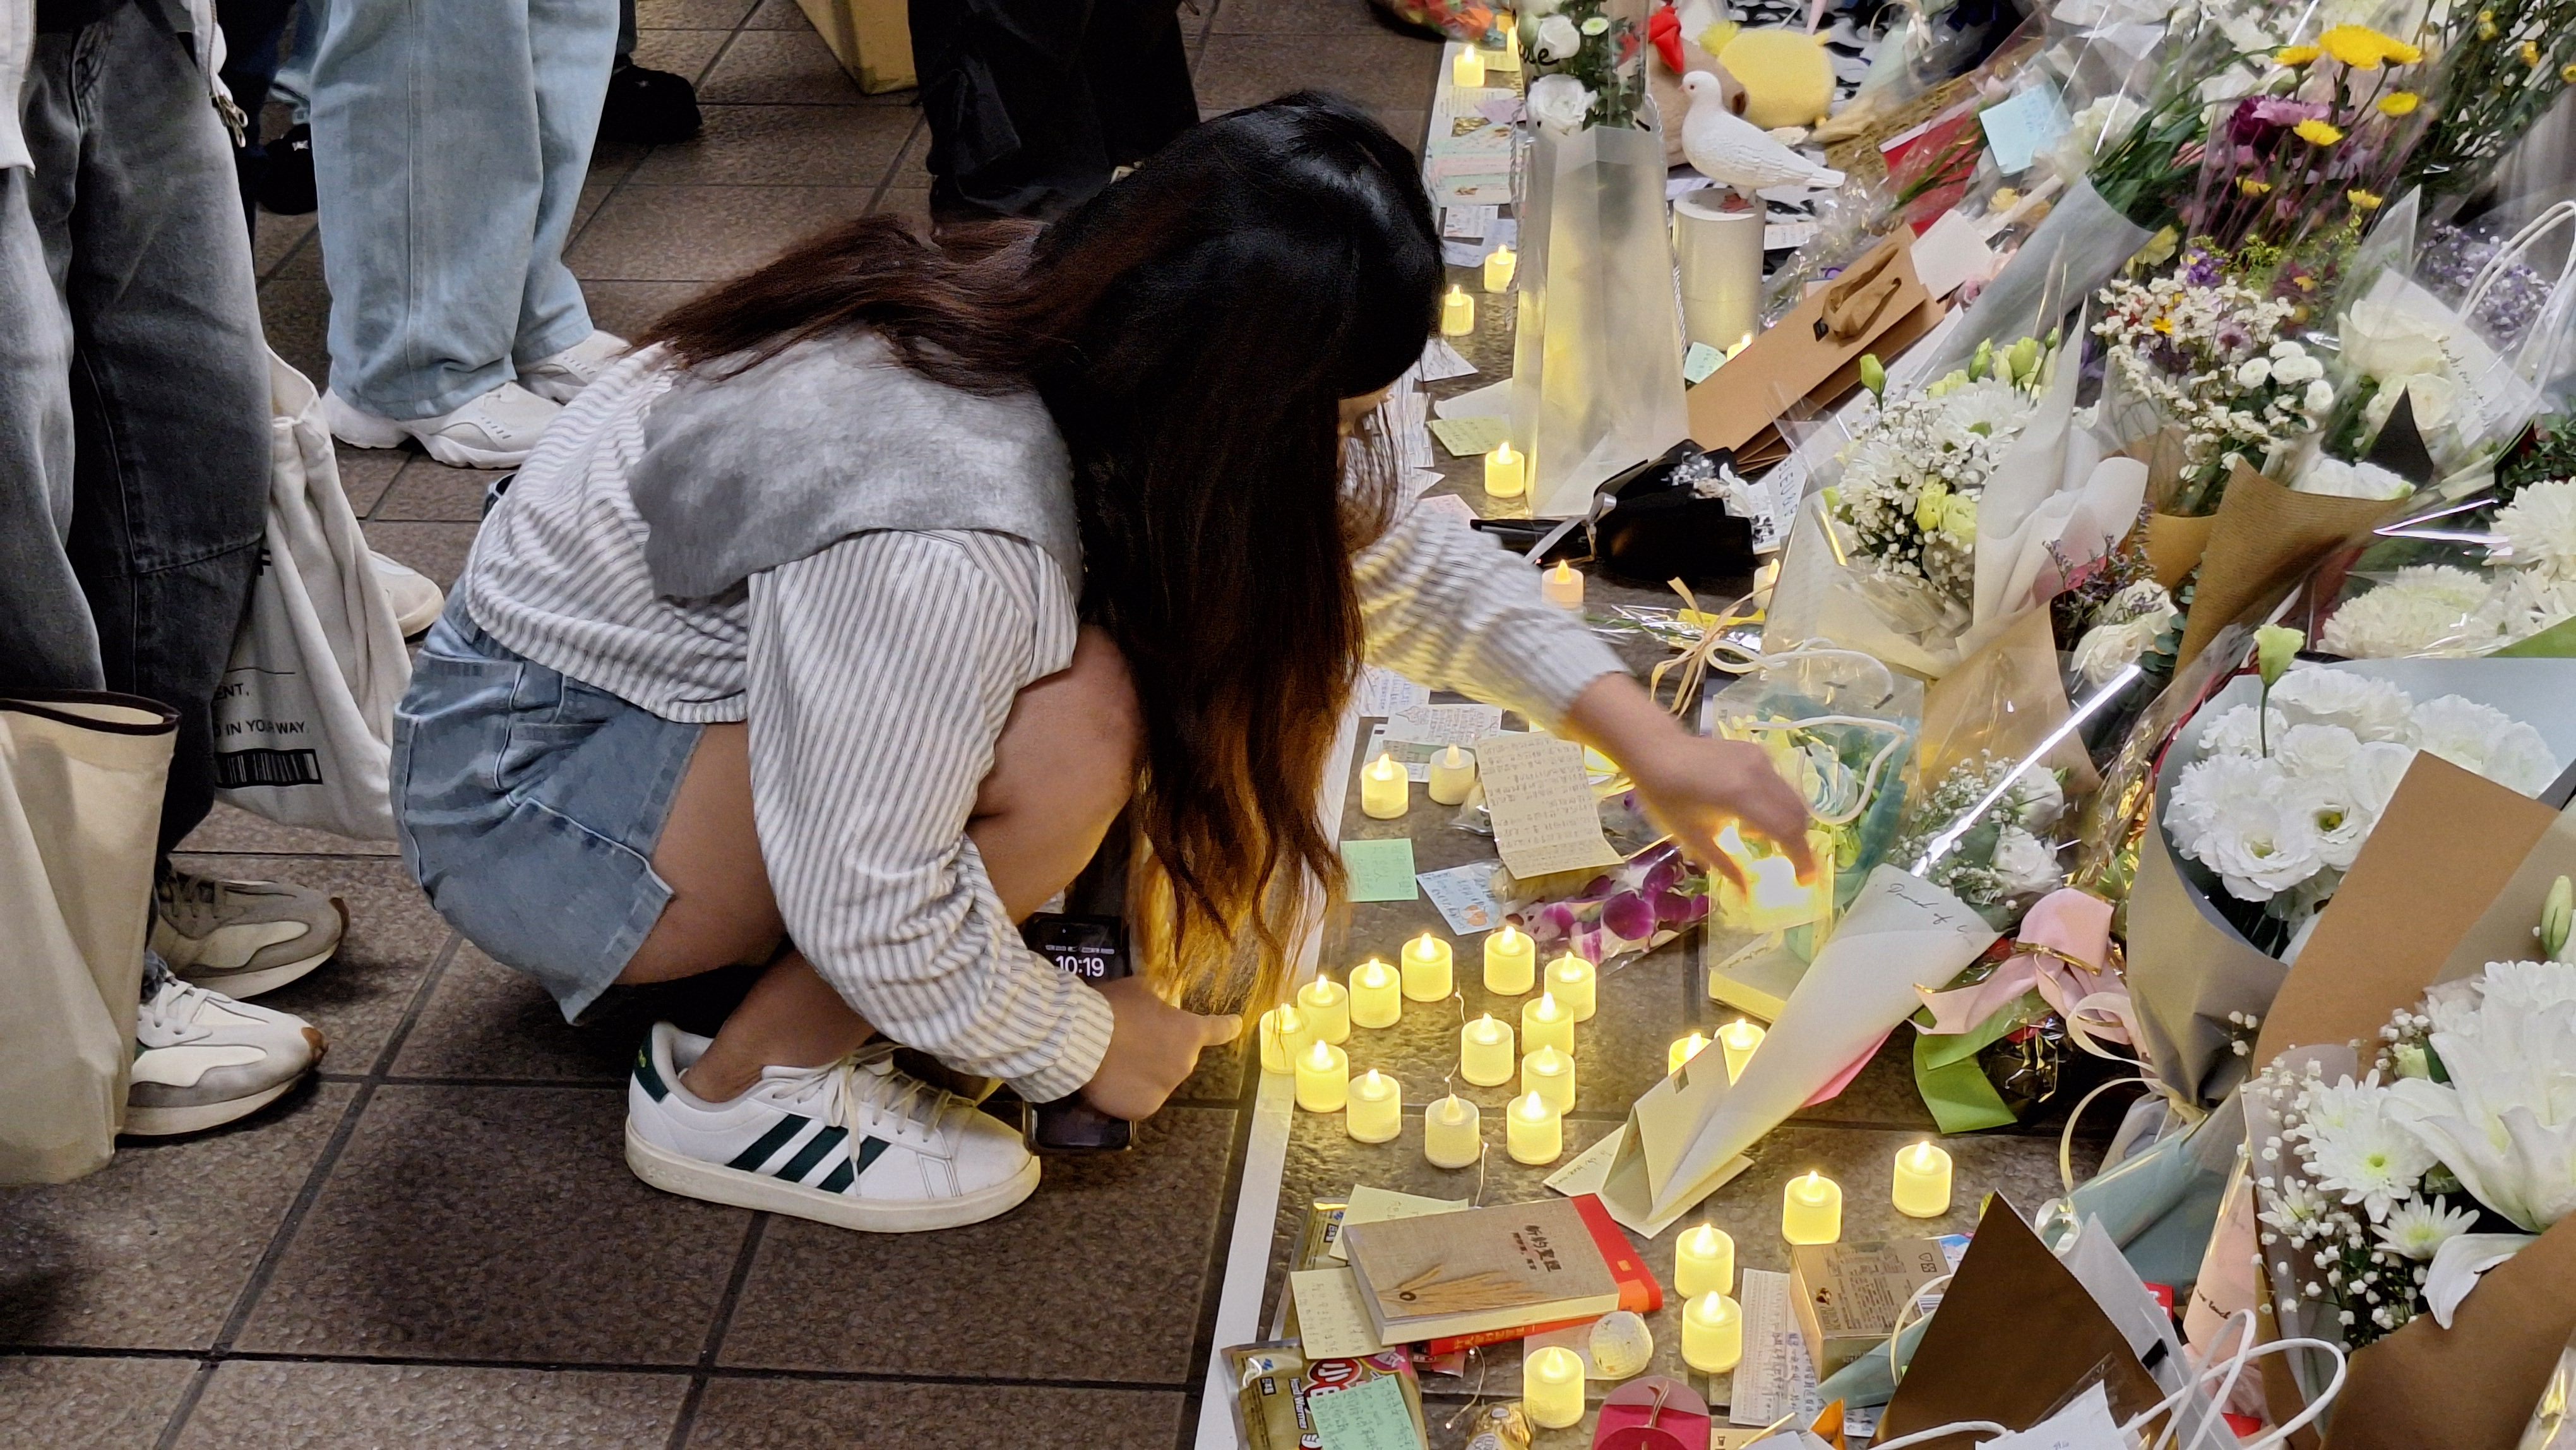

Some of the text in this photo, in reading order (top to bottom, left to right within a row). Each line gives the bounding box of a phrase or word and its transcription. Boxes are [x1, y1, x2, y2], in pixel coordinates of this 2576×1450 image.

[226, 722, 242, 736] IN
[1055, 955, 1105, 978] 10:19
[1294, 1396, 1308, 1429] Warmer
